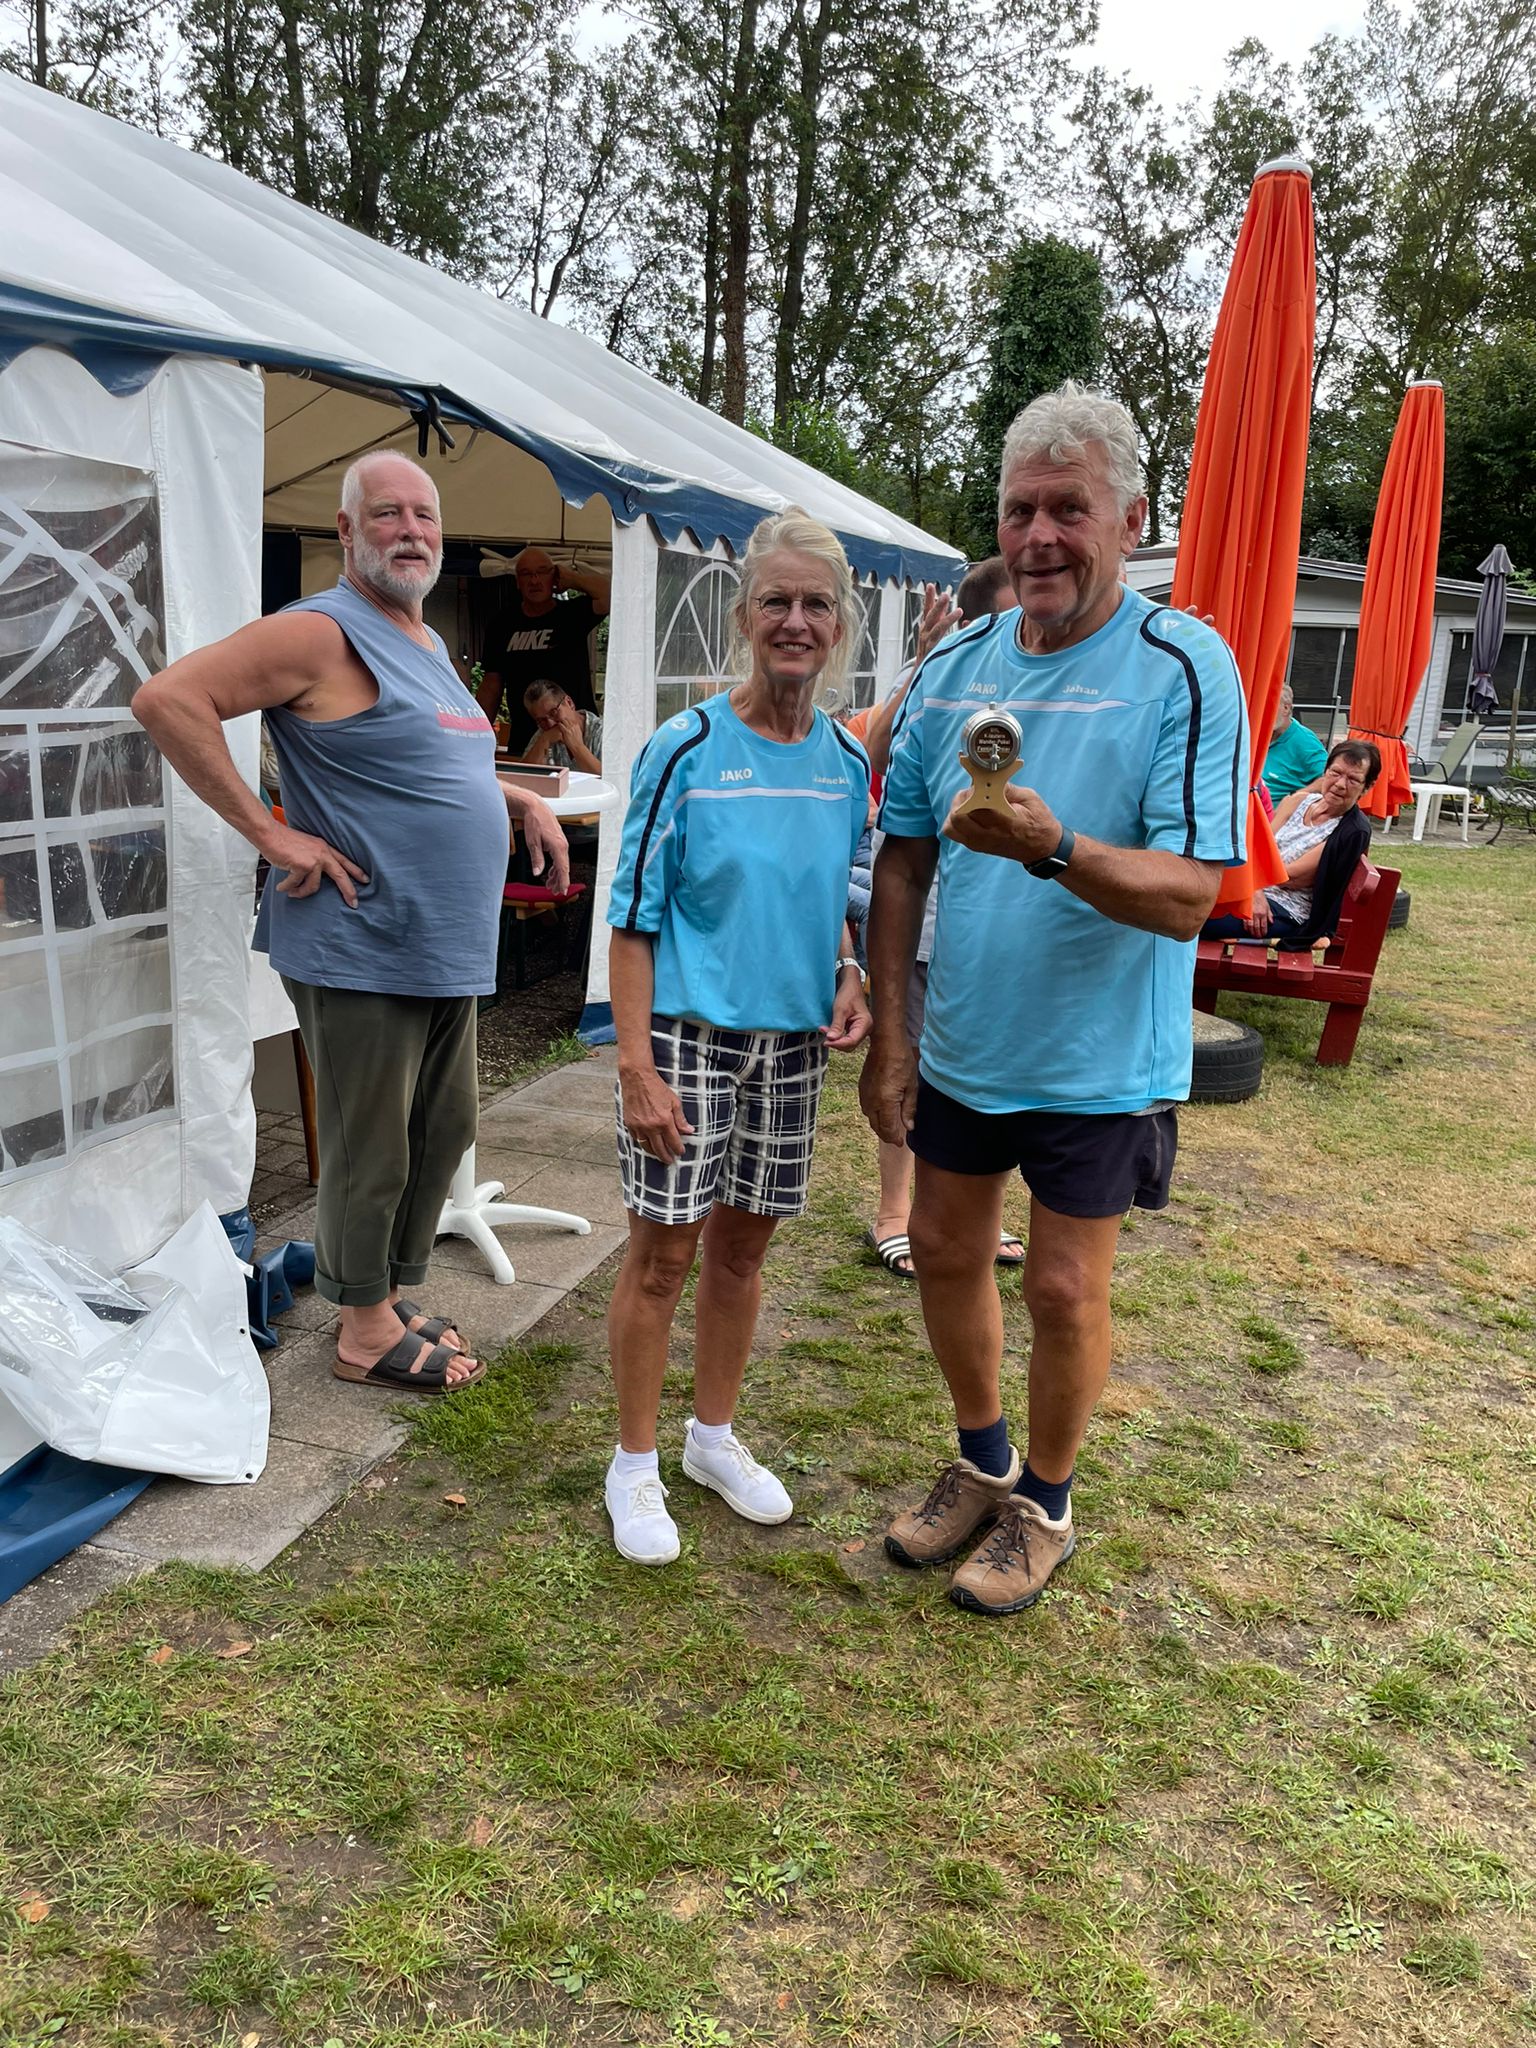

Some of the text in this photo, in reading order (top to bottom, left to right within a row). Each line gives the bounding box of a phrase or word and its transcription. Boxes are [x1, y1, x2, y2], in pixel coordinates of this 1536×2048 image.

[507, 629, 553, 651] NIKE
[968, 682, 998, 695] JAKO
[720, 768, 752, 782] JAKO
